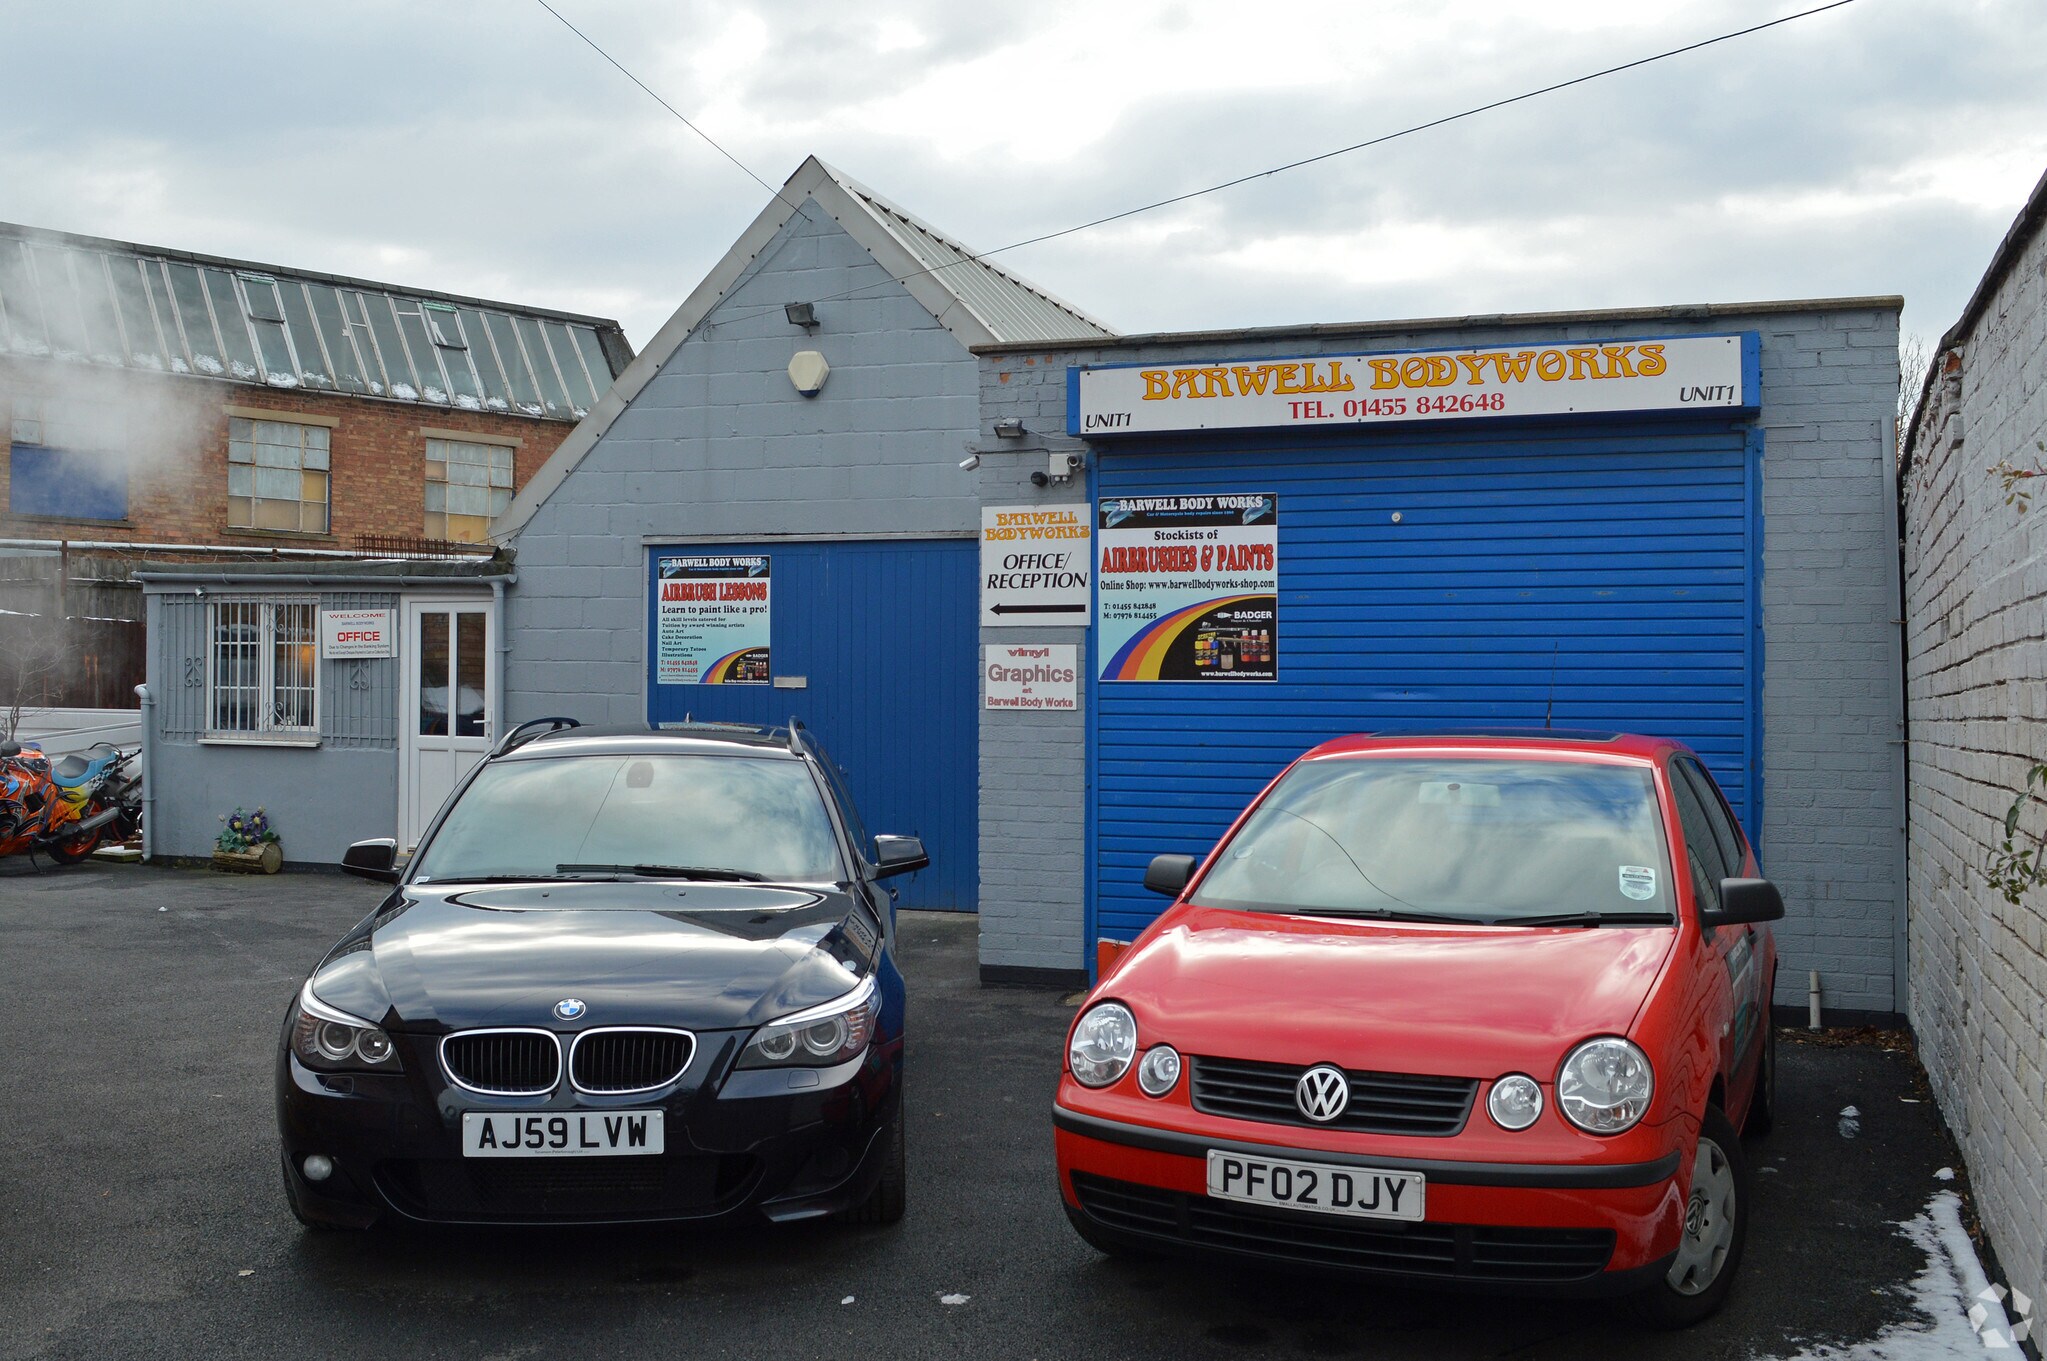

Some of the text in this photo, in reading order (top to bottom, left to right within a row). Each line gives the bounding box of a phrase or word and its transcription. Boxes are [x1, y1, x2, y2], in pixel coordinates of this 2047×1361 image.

[1140, 344, 1666, 400] BARWELL BODYWORKS
[1679, 385, 1735, 402] UNIT1
[1288, 393, 1505, 419] TEL. 01455 842648
[1086, 413, 1131, 428] UNIT1
[1119, 496, 1263, 512] BARWELL BODY WORKS
[996, 511, 1078, 526] BARWELL
[985, 526, 1090, 540] BODYWORKS
[1154, 530, 1218, 541] Stockists of
[671, 557, 762, 567] BARWELL BODY WORKS
[1003, 552, 1072, 570] OFFICE/
[1101, 543, 1274, 573] AIRBRUSHES & PAINTS
[987, 572, 1087, 589] RECEPTION
[1100, 578, 1275, 592] Online Shop: www.barwellbodyworks-shop.com
[661, 582, 767, 601] AIRBRUSH LESSONS
[662, 605, 686, 614] Learn
[699, 605, 721, 615] paint
[723, 605, 740, 613] like
[749, 605, 767, 615] pro!
[1112, 603, 1132, 611] 01455
[1234, 611, 1272, 619] BADGER
[337, 631, 380, 642] OFFICE
[1008, 648, 1049, 658] vinyl
[988, 663, 1074, 685] Graphics
[988, 697, 1073, 708] Barwell Body Works
[478, 1115, 647, 1149] AJ59 LVW
[1222, 1158, 1407, 1212] PF02 DJY
